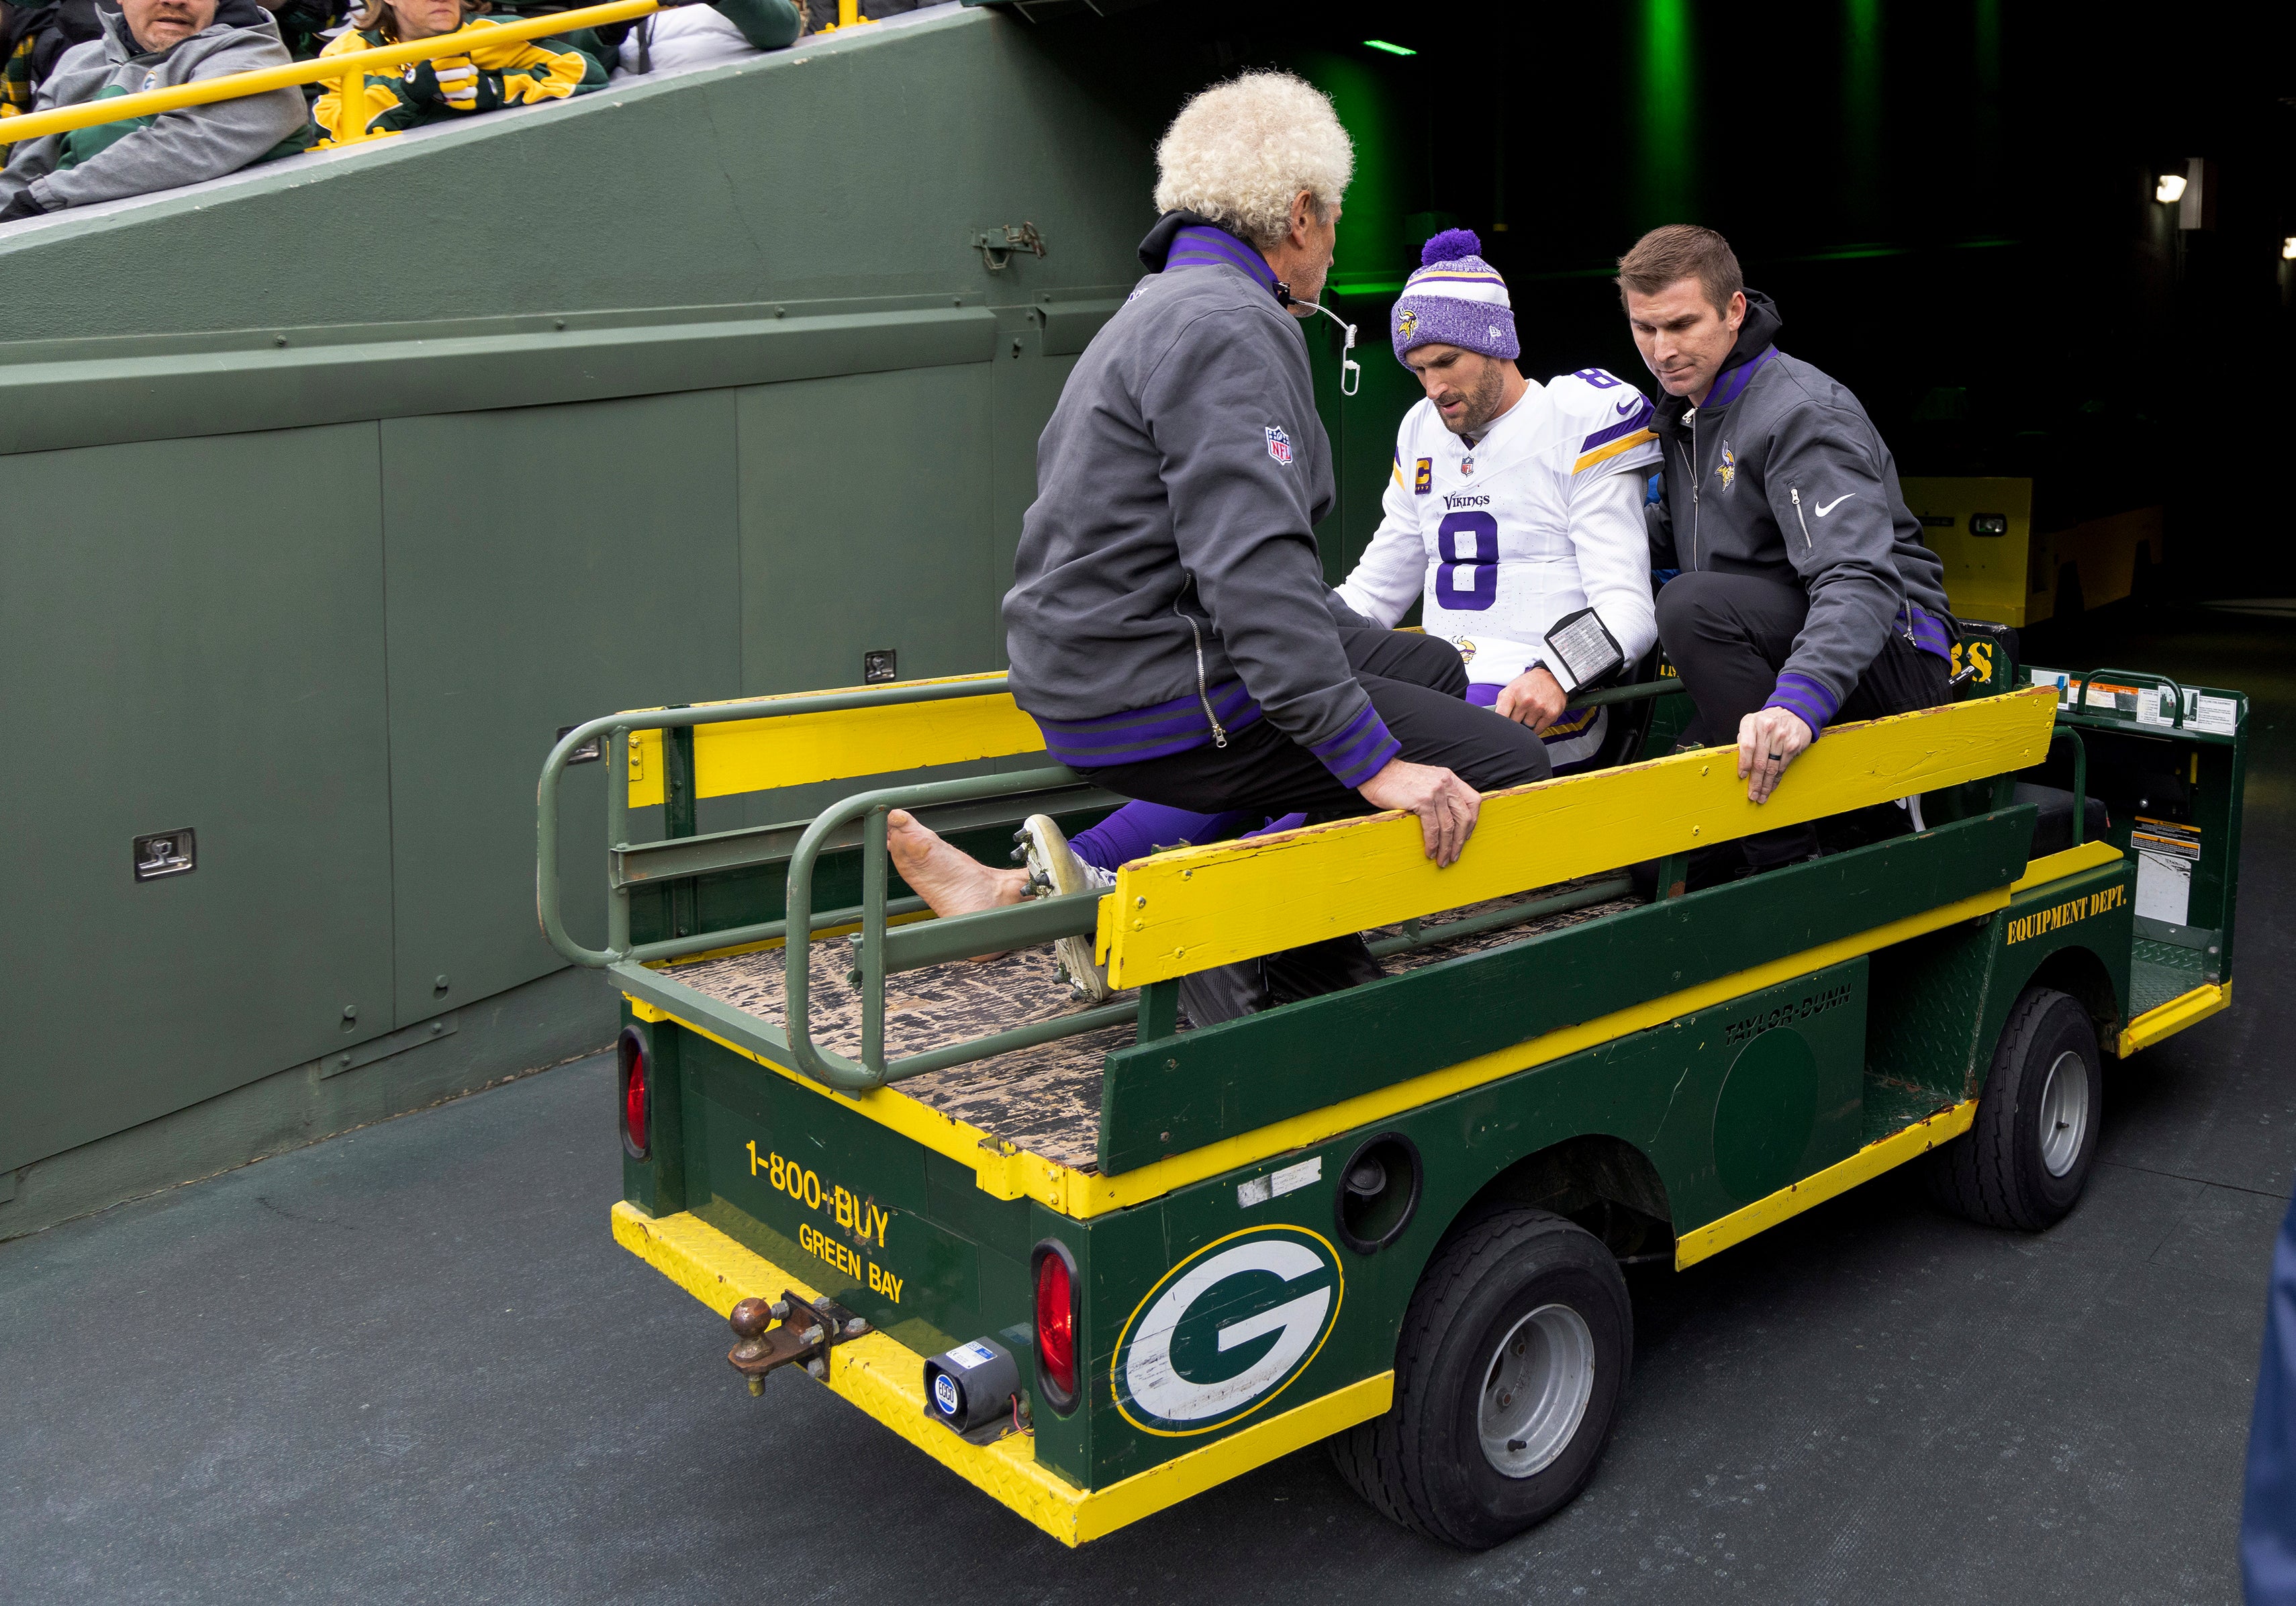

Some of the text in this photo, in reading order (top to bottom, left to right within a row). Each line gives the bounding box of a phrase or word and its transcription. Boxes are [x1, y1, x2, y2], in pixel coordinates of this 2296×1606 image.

[1574, 368, 1622, 389] 8
[1270, 440, 1291, 461] NFL
[1417, 460, 1430, 485] C
[1461, 463, 1473, 473] NFL
[1435, 510, 1500, 611] 8
[2007, 884, 2127, 946] EQUIPMENT DEPT.
[1725, 982, 1853, 1047] TAYLOR-DUNN
[746, 1139, 888, 1248] 1-800-BUY
[799, 1223, 904, 1304] GREEN BAY
[1127, 1240, 1331, 1421] G
[939, 1381, 954, 1403] ECCO
